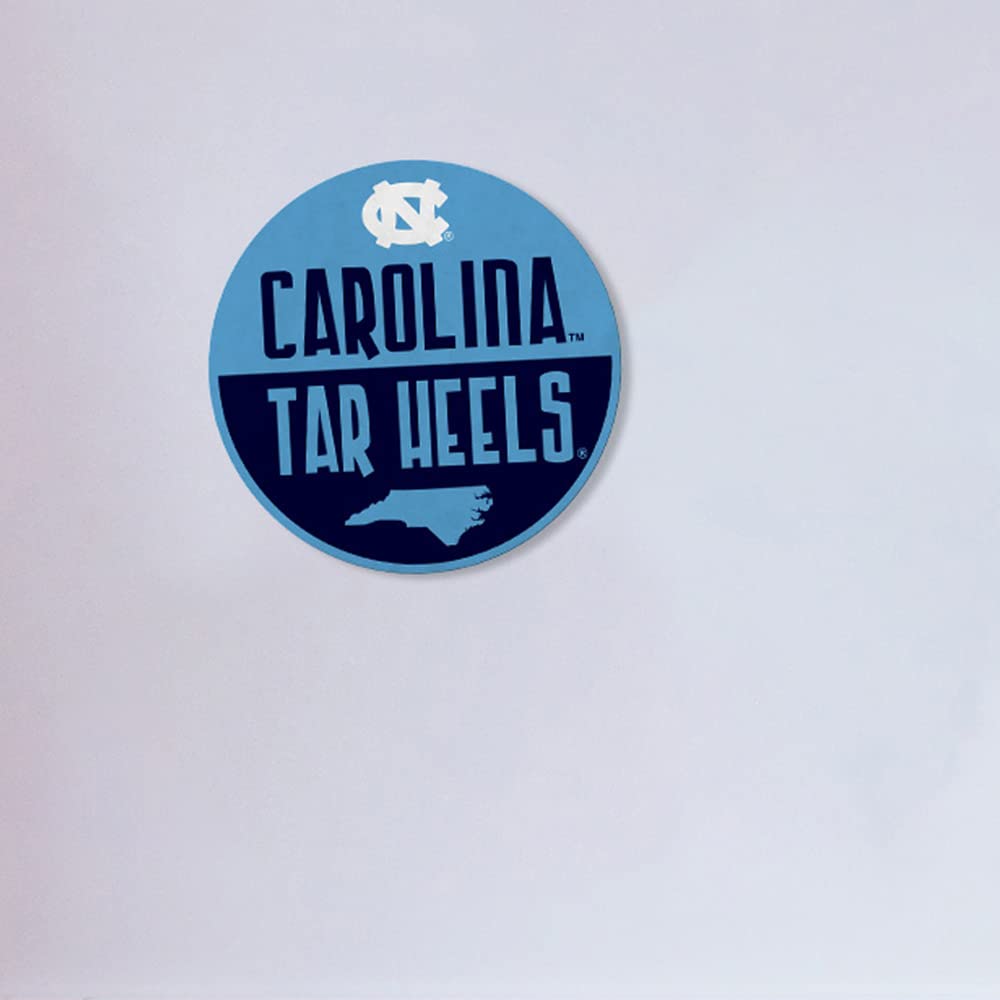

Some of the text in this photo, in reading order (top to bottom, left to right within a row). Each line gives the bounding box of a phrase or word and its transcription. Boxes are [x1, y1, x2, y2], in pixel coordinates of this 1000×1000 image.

[260, 256, 567, 360] CAROLINA
[267, 370, 575, 478] TAR HEELS
